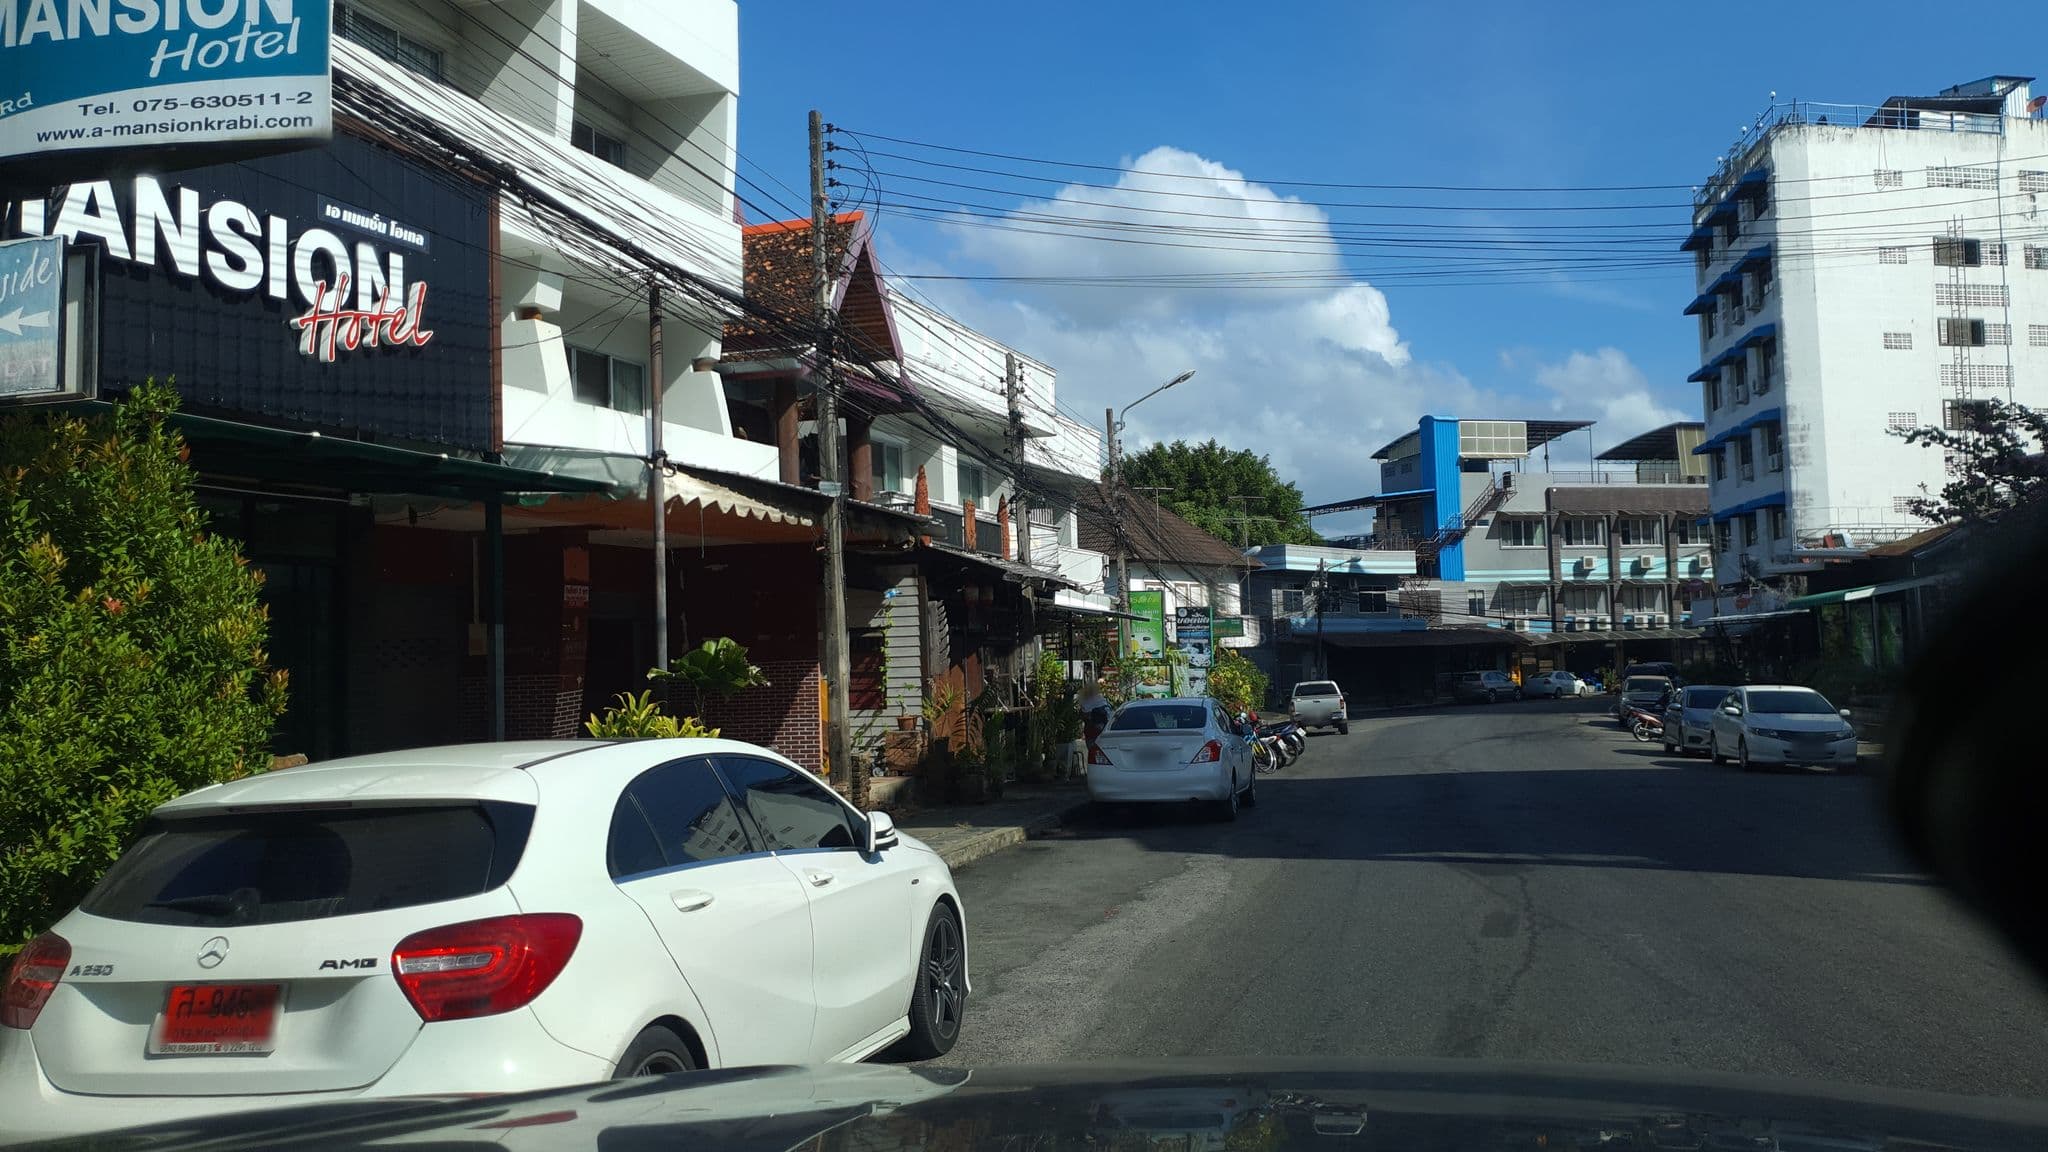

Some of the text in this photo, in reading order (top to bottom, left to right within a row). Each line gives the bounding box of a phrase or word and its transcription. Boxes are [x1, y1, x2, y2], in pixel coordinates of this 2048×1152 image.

[149, 16, 300, 78] Hotel
[79, 91, 313, 117] Tel. 075-630511-2
[36, 114, 313, 143] www.a-mansionkrabi.com
[325, 204, 341, 219] เอ
[297, 273, 432, 361] Hotel
[318, 957, 378, 970] AMG
